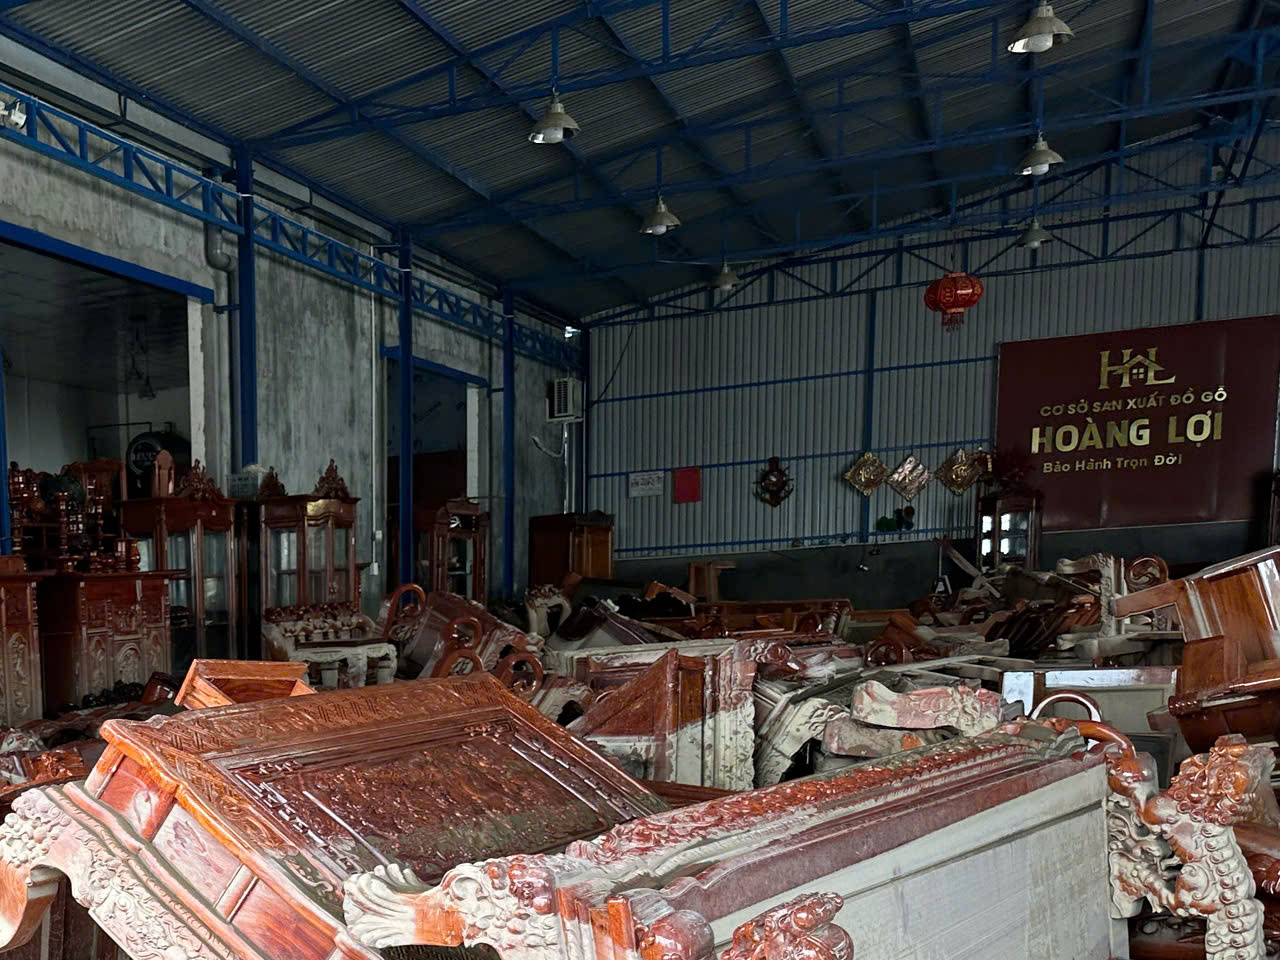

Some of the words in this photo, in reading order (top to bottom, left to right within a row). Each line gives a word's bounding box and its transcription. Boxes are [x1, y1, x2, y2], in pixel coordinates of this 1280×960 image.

[1040, 403, 1065, 417] CƠ
[1067, 399, 1089, 415] SỞ
[1126, 391, 1166, 411] XUẤT
[1169, 387, 1195, 406] ĐỒ
[1200, 386, 1228, 402] GỖ
[1031, 417, 1151, 454] HOÀNG
[1168, 410, 1223, 448] LỢI
[1043, 459, 1071, 473] Bảo
[1075, 458, 1112, 472] Hành
[1116, 457, 1148, 470] Trọn
[1154, 454, 1183, 467] Đời
